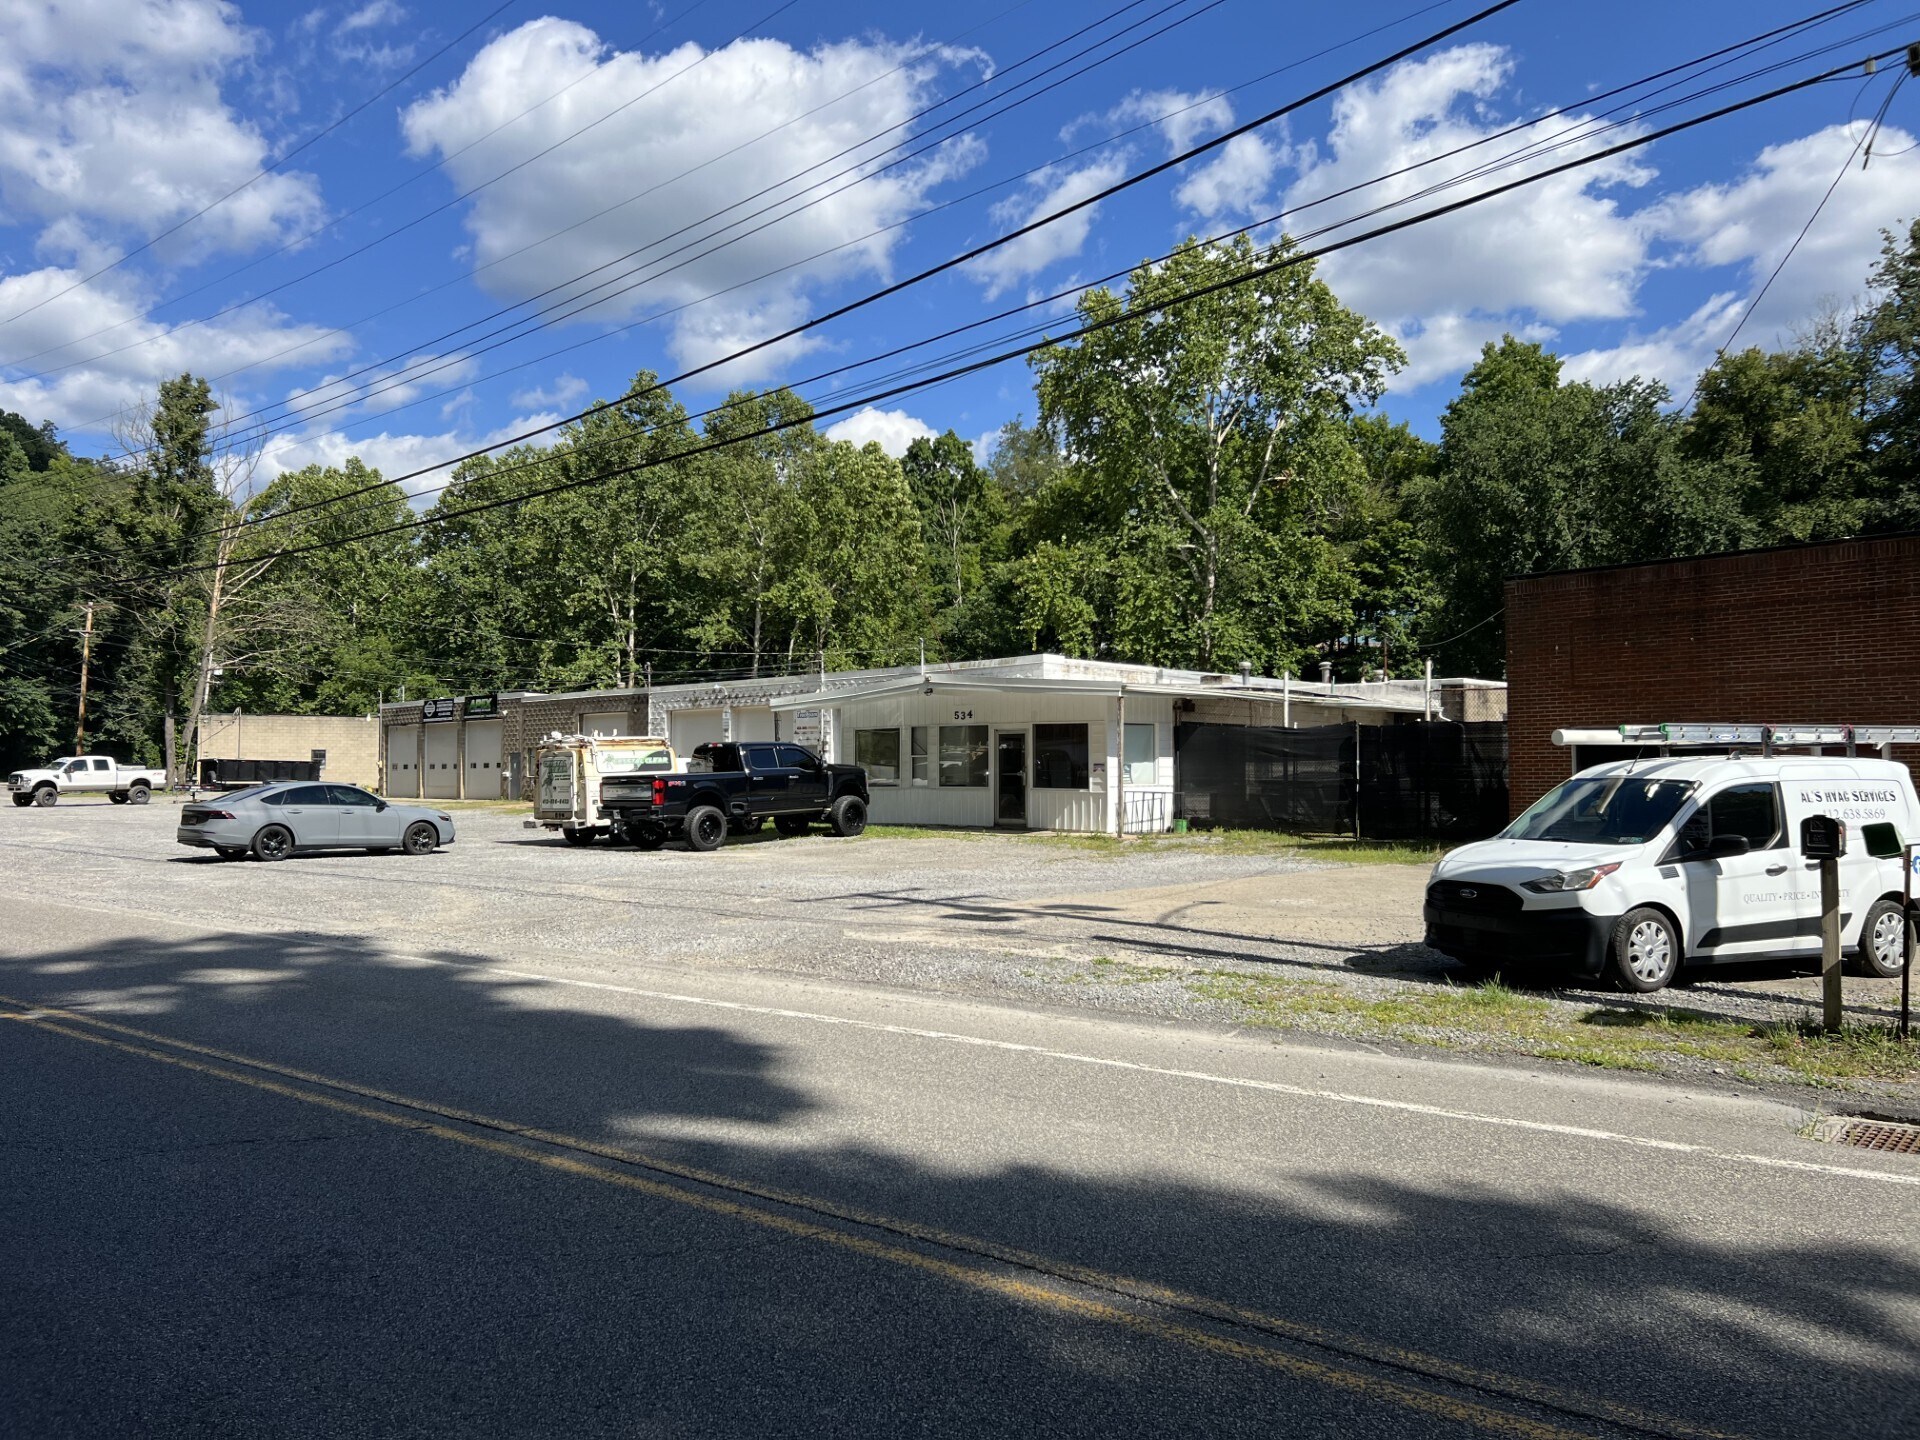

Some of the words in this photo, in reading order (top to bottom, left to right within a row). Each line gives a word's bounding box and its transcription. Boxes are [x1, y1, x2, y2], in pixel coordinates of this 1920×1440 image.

[954, 709, 973, 721] 534
[1801, 791, 1823, 803] AL'S
[1852, 790, 1897, 802] SERVICES
[1743, 892, 1778, 904] QUALITY
[1783, 891, 1806, 901] PRICE
